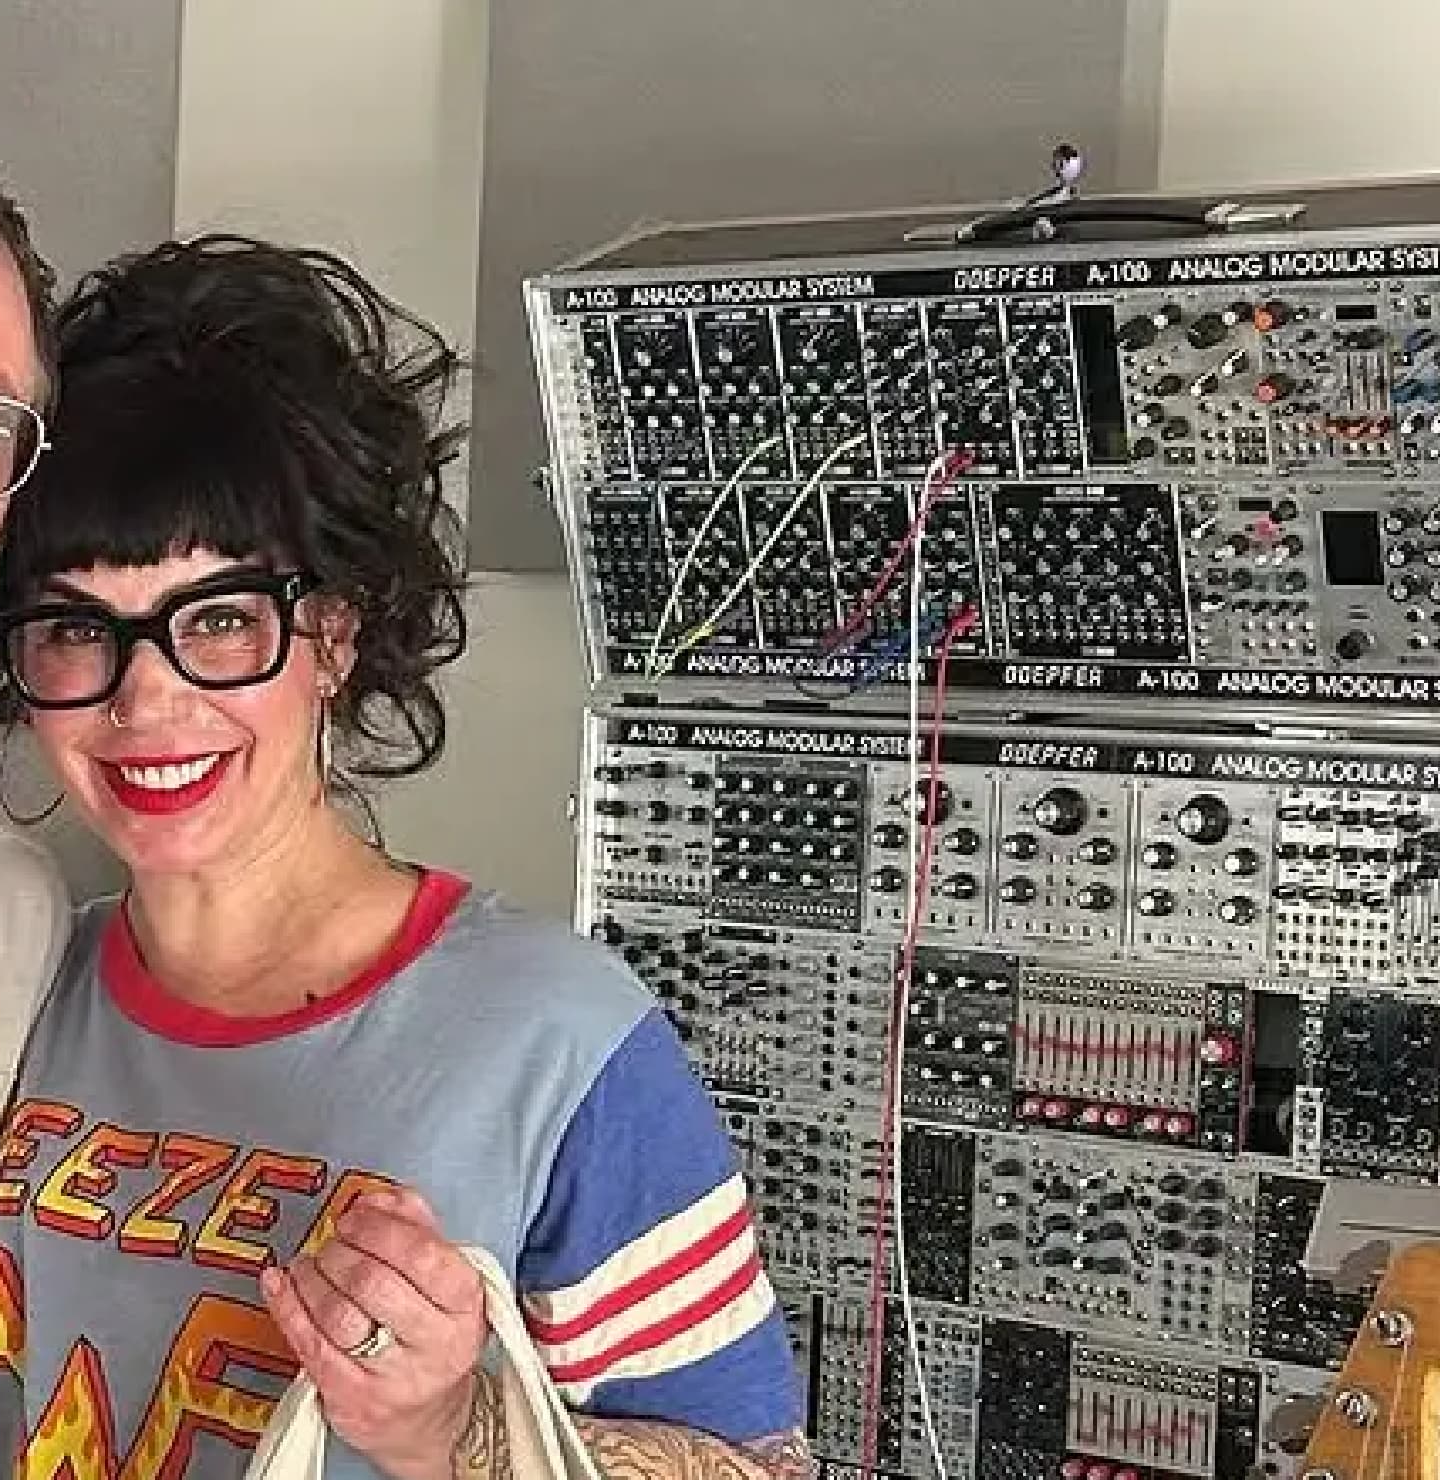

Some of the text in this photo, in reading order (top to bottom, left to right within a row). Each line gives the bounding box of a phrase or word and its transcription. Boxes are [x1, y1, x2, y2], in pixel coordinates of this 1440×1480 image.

[953, 266, 1055, 290] DOEPFER
[1086, 260, 1152, 285] A-100
[1167, 255, 1264, 281] ANALOG
[1270, 249, 1386, 276] MODULAR
[565, 275, 875, 309] A-100 ANALOG MODULAR SYSTEM
[687, 653, 762, 674] ANALOG
[765, 655, 855, 677] MODULAR
[1005, 665, 1103, 687] DOEPFER
[1136, 669, 1200, 691] A-100
[1217, 672, 1310, 695] ANALOG
[1316, 675, 1429, 700] MODULAR
[628, 723, 679, 745] A-100
[691, 726, 764, 748] ANALOG
[766, 729, 855, 752] MODULAR
[998, 743, 1098, 768] DOEPFER
[1132, 750, 1196, 772] A-100
[1211, 753, 1304, 779] ANALOG
[1306, 759, 1419, 785] MODULAR
